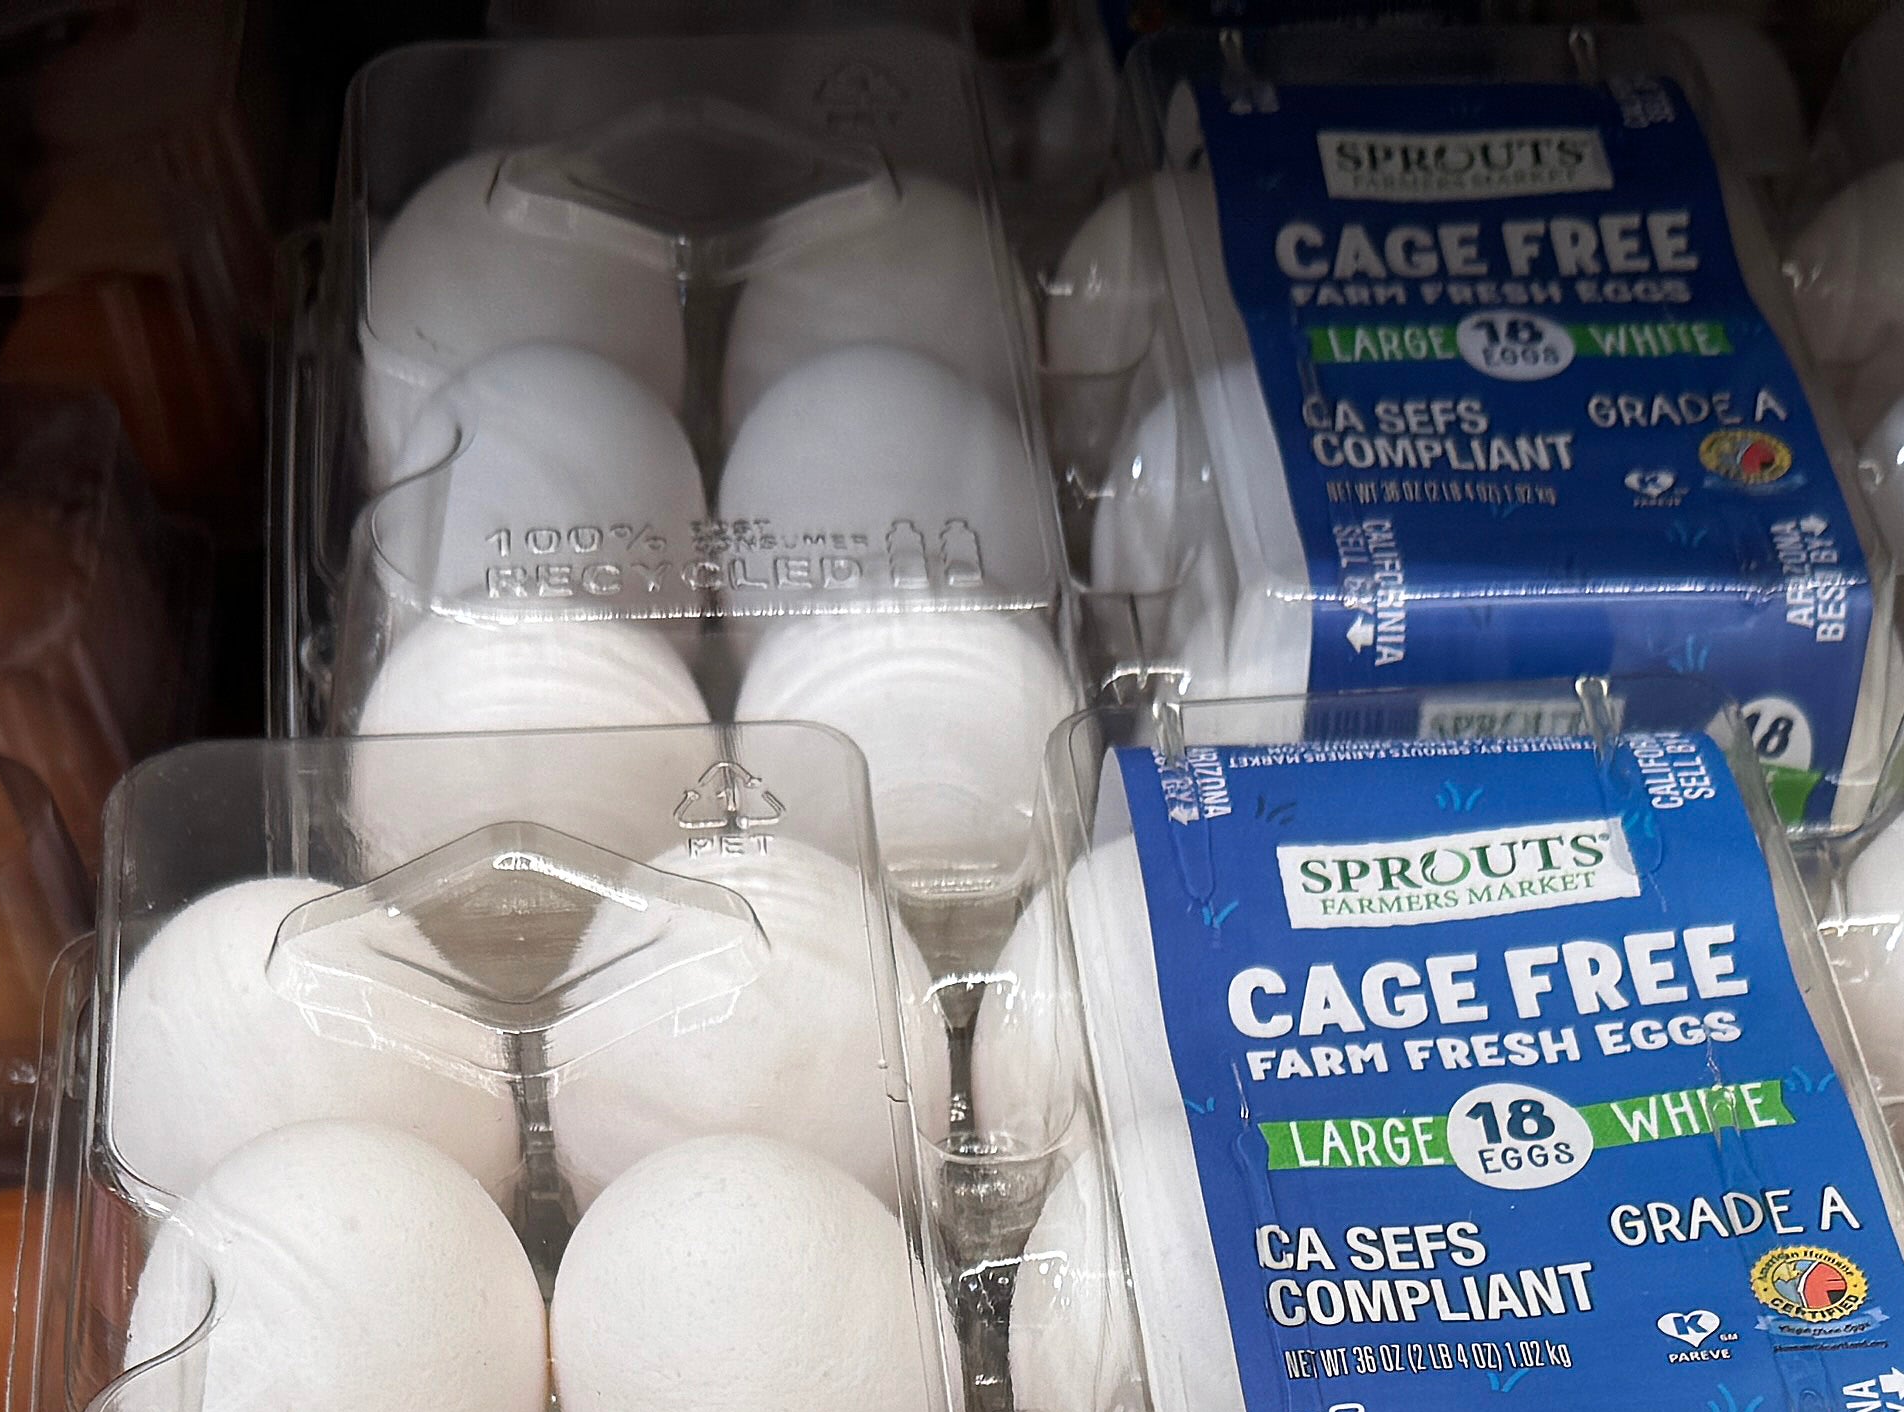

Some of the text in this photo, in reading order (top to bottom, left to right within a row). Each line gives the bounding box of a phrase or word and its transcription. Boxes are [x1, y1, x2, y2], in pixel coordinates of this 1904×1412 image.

[1275, 213, 1699, 281] CAGE FREE
[1328, 323, 1722, 362] LARGE WHITE
[1377, 402, 1488, 434] SEFS
[1588, 392, 1789, 428] GRADE A
[1310, 434, 1574, 471] COMPLIANT
[486, 561, 863, 598] RECYCLED
[1321, 870, 1597, 916] FARMERS MARKET
[1227, 923, 1749, 1040] CAGE FREE
[1247, 1011, 1742, 1082] FARM FRESH EGGS
[1296, 1115, 1444, 1169] LARGE
[1465, 1098, 1557, 1144] 18
[1479, 1141, 1576, 1174] EGGS
[1610, 1187, 1862, 1248] GRADE A
[1256, 1220, 1487, 1273] CA SEFS
[1269, 1261, 1595, 1327] COMPLIANT
